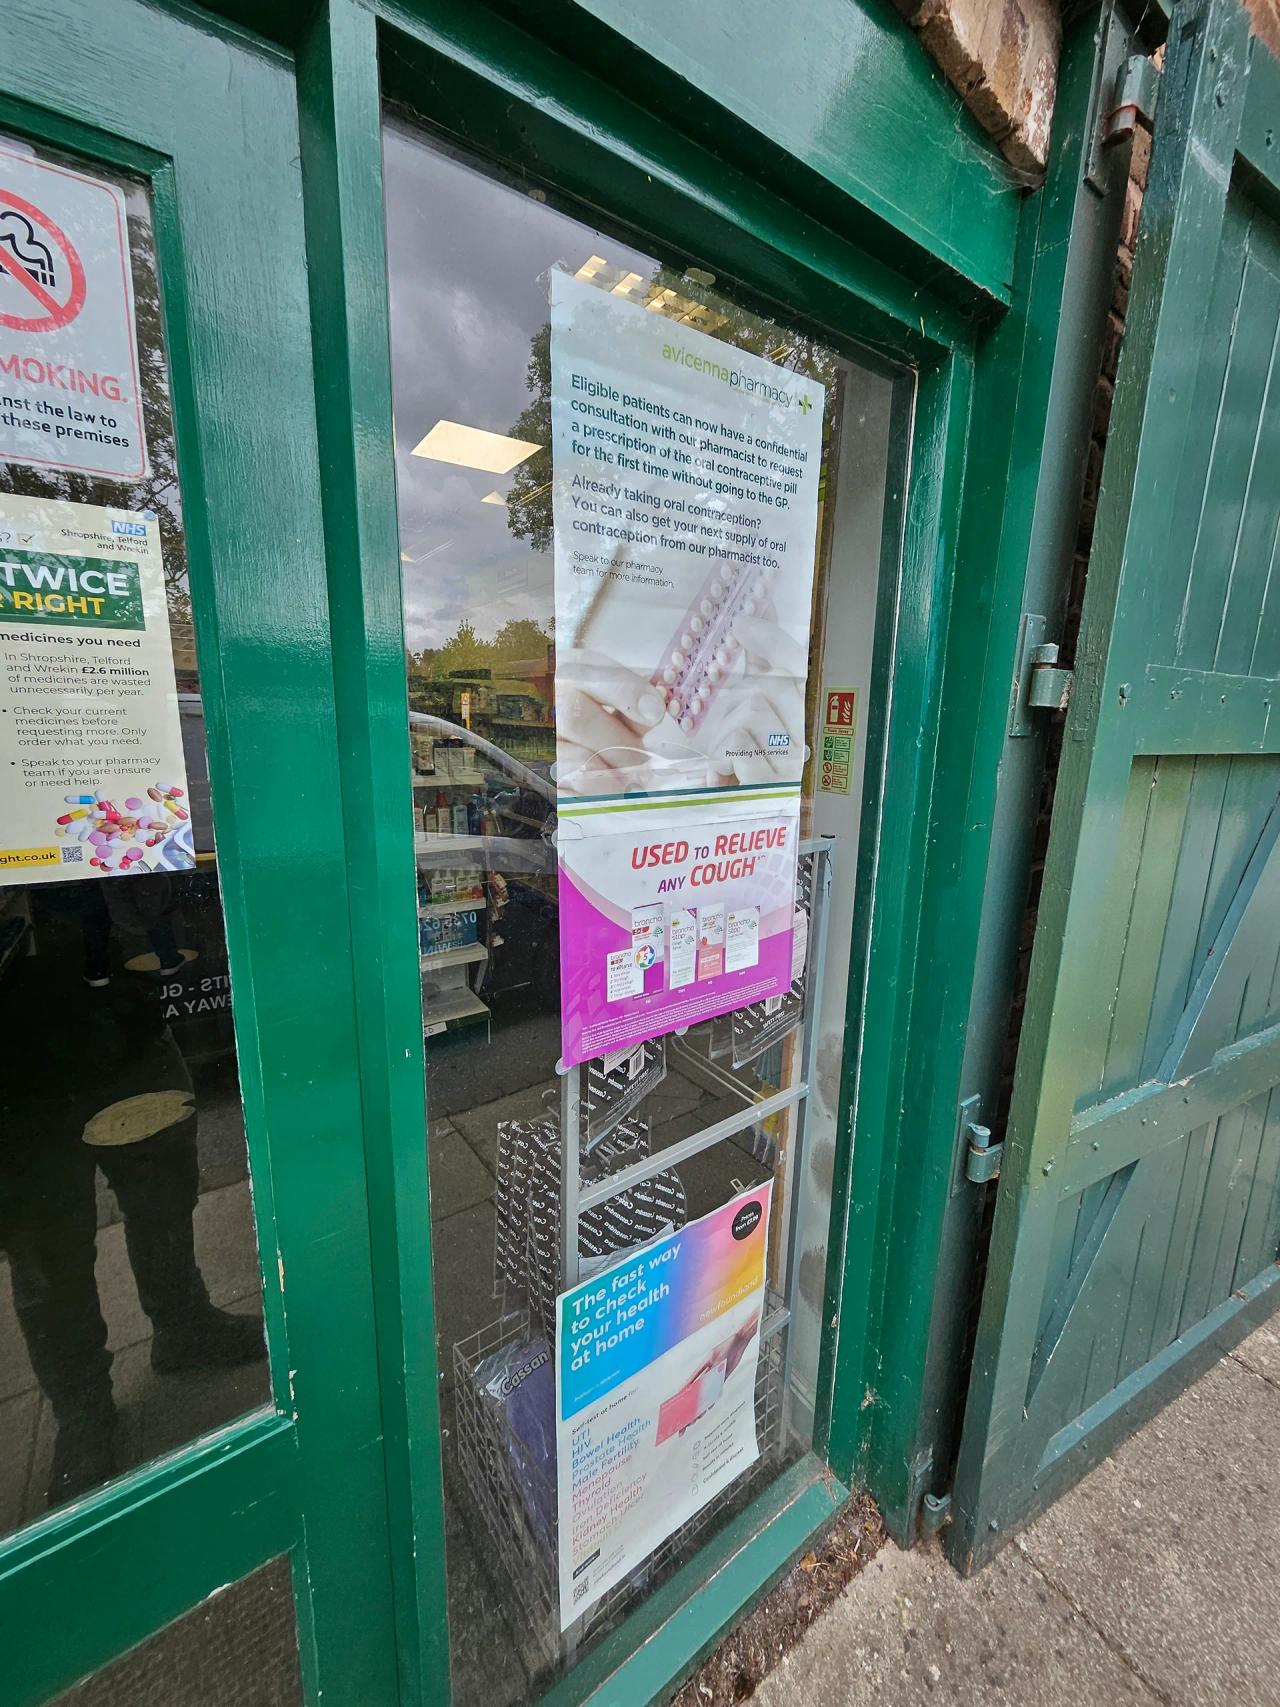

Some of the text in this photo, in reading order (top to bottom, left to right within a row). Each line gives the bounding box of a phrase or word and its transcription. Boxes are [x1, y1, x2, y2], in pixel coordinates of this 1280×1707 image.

[662, 343, 793, 408] avicennapharmacy
[1, 412, 129, 447] these premises
[35, 401, 117, 428] the law to
[571, 373, 808, 463] Eligible patients can now have a confidential
[571, 399, 803, 479] consultation with our pharmacist to request
[571, 421, 798, 495] a prescription of the oral contraceptive pill
[572, 440, 790, 510] for the first time without going to the GP.
[572, 474, 762, 529] Already taking oral contraception?
[61, 529, 148, 546] Shropshire, Telford
[113, 521, 145, 535] NHS
[572, 495, 787, 553] You can also get your next supply of oral
[572, 519, 780, 569] contraception from our pharmacist too.
[0, 562, 129, 596] TWICE
[573, 551, 664, 575] Speak to our pharmacy
[573, 565, 595, 577] team
[596, 568, 608, 578] for
[609, 571, 630, 582] more
[12, 591, 105, 615] RIGHT
[0, 632, 141, 648] medicines you need
[4, 652, 131, 665] In Shropshire, Telford
[6, 663, 149, 676] and Wrekin £2.6 million
[8, 674, 20, 683] of
[24, 675, 87, 685] medicines
[111, 677, 151, 687] wasted
[10, 685, 144, 697] unnecessarily per year.
[13, 706, 127, 717] Check your current
[16, 717, 118, 726] medicines before
[17, 727, 147, 737] requesting more. Only
[18, 737, 142, 747] order what you need.
[769, 735, 789, 746] NHS
[21, 756, 161, 768] Speak to your pharmacy
[725, 749, 753, 758] Providing
[767, 748, 789, 756] services
[23, 769, 55, 777] team
[58, 768, 66, 776] if
[68, 768, 90, 777] you
[114, 767, 151, 775] unsure
[25, 777, 102, 787] or need help.
[631, 826, 787, 870] USED TO RELIEVE
[657, 875, 687, 893] ANY
[634, 916, 663, 927] broncho
[572, 1243, 681, 1316] The fast way
[570, 1282, 670, 1357] your health
[571, 1279, 647, 1334] to check
[571, 1318, 645, 1371] at home
[500, 1351, 549, 1396] Cassan
[572, 1395, 628, 1435] Self-test at home
[572, 1426, 590, 1447] UTI
[572, 1417, 641, 1469] Bowel Health
[572, 1438, 592, 1459] HIV
[572, 1419, 651, 1480] Prostate Health
[572, 1438, 640, 1491] Male Fertility
[572, 1454, 632, 1502] Menopause
[572, 1477, 611, 1512] Thyroid
[572, 1481, 623, 1523] Ovulation
[572, 1472, 647, 1535] Iron Deficiency
[572, 1486, 642, 1546] Kidney Health
